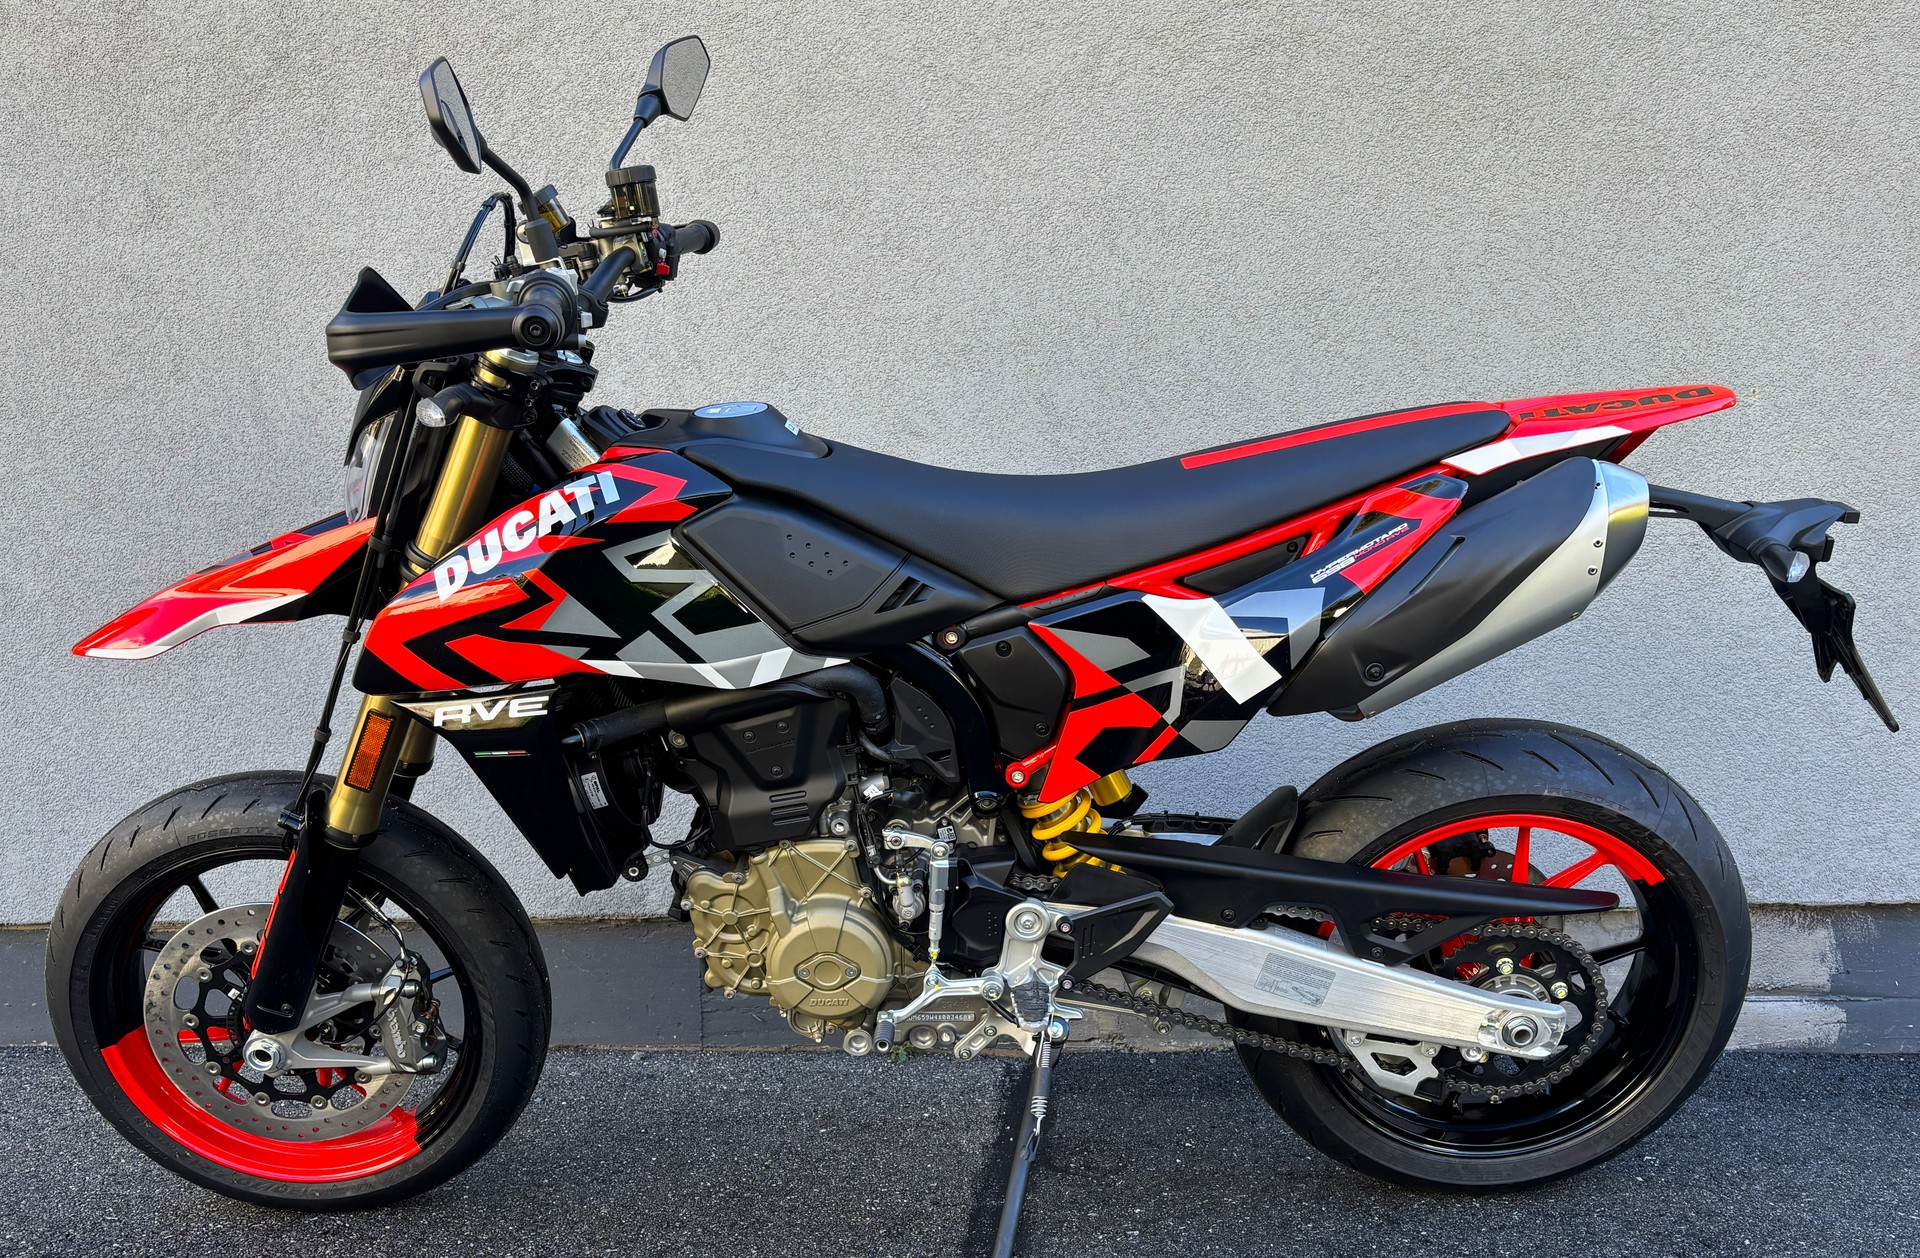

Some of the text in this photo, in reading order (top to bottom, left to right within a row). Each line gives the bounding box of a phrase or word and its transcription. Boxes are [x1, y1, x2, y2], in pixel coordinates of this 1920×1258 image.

[1519, 387, 1714, 420] DUCATI
[433, 470, 620, 602] DUCATI
[433, 696, 550, 727] RVE
[810, 997, 849, 1007] DUCATI
[386, 1007, 407, 1059] brembo
